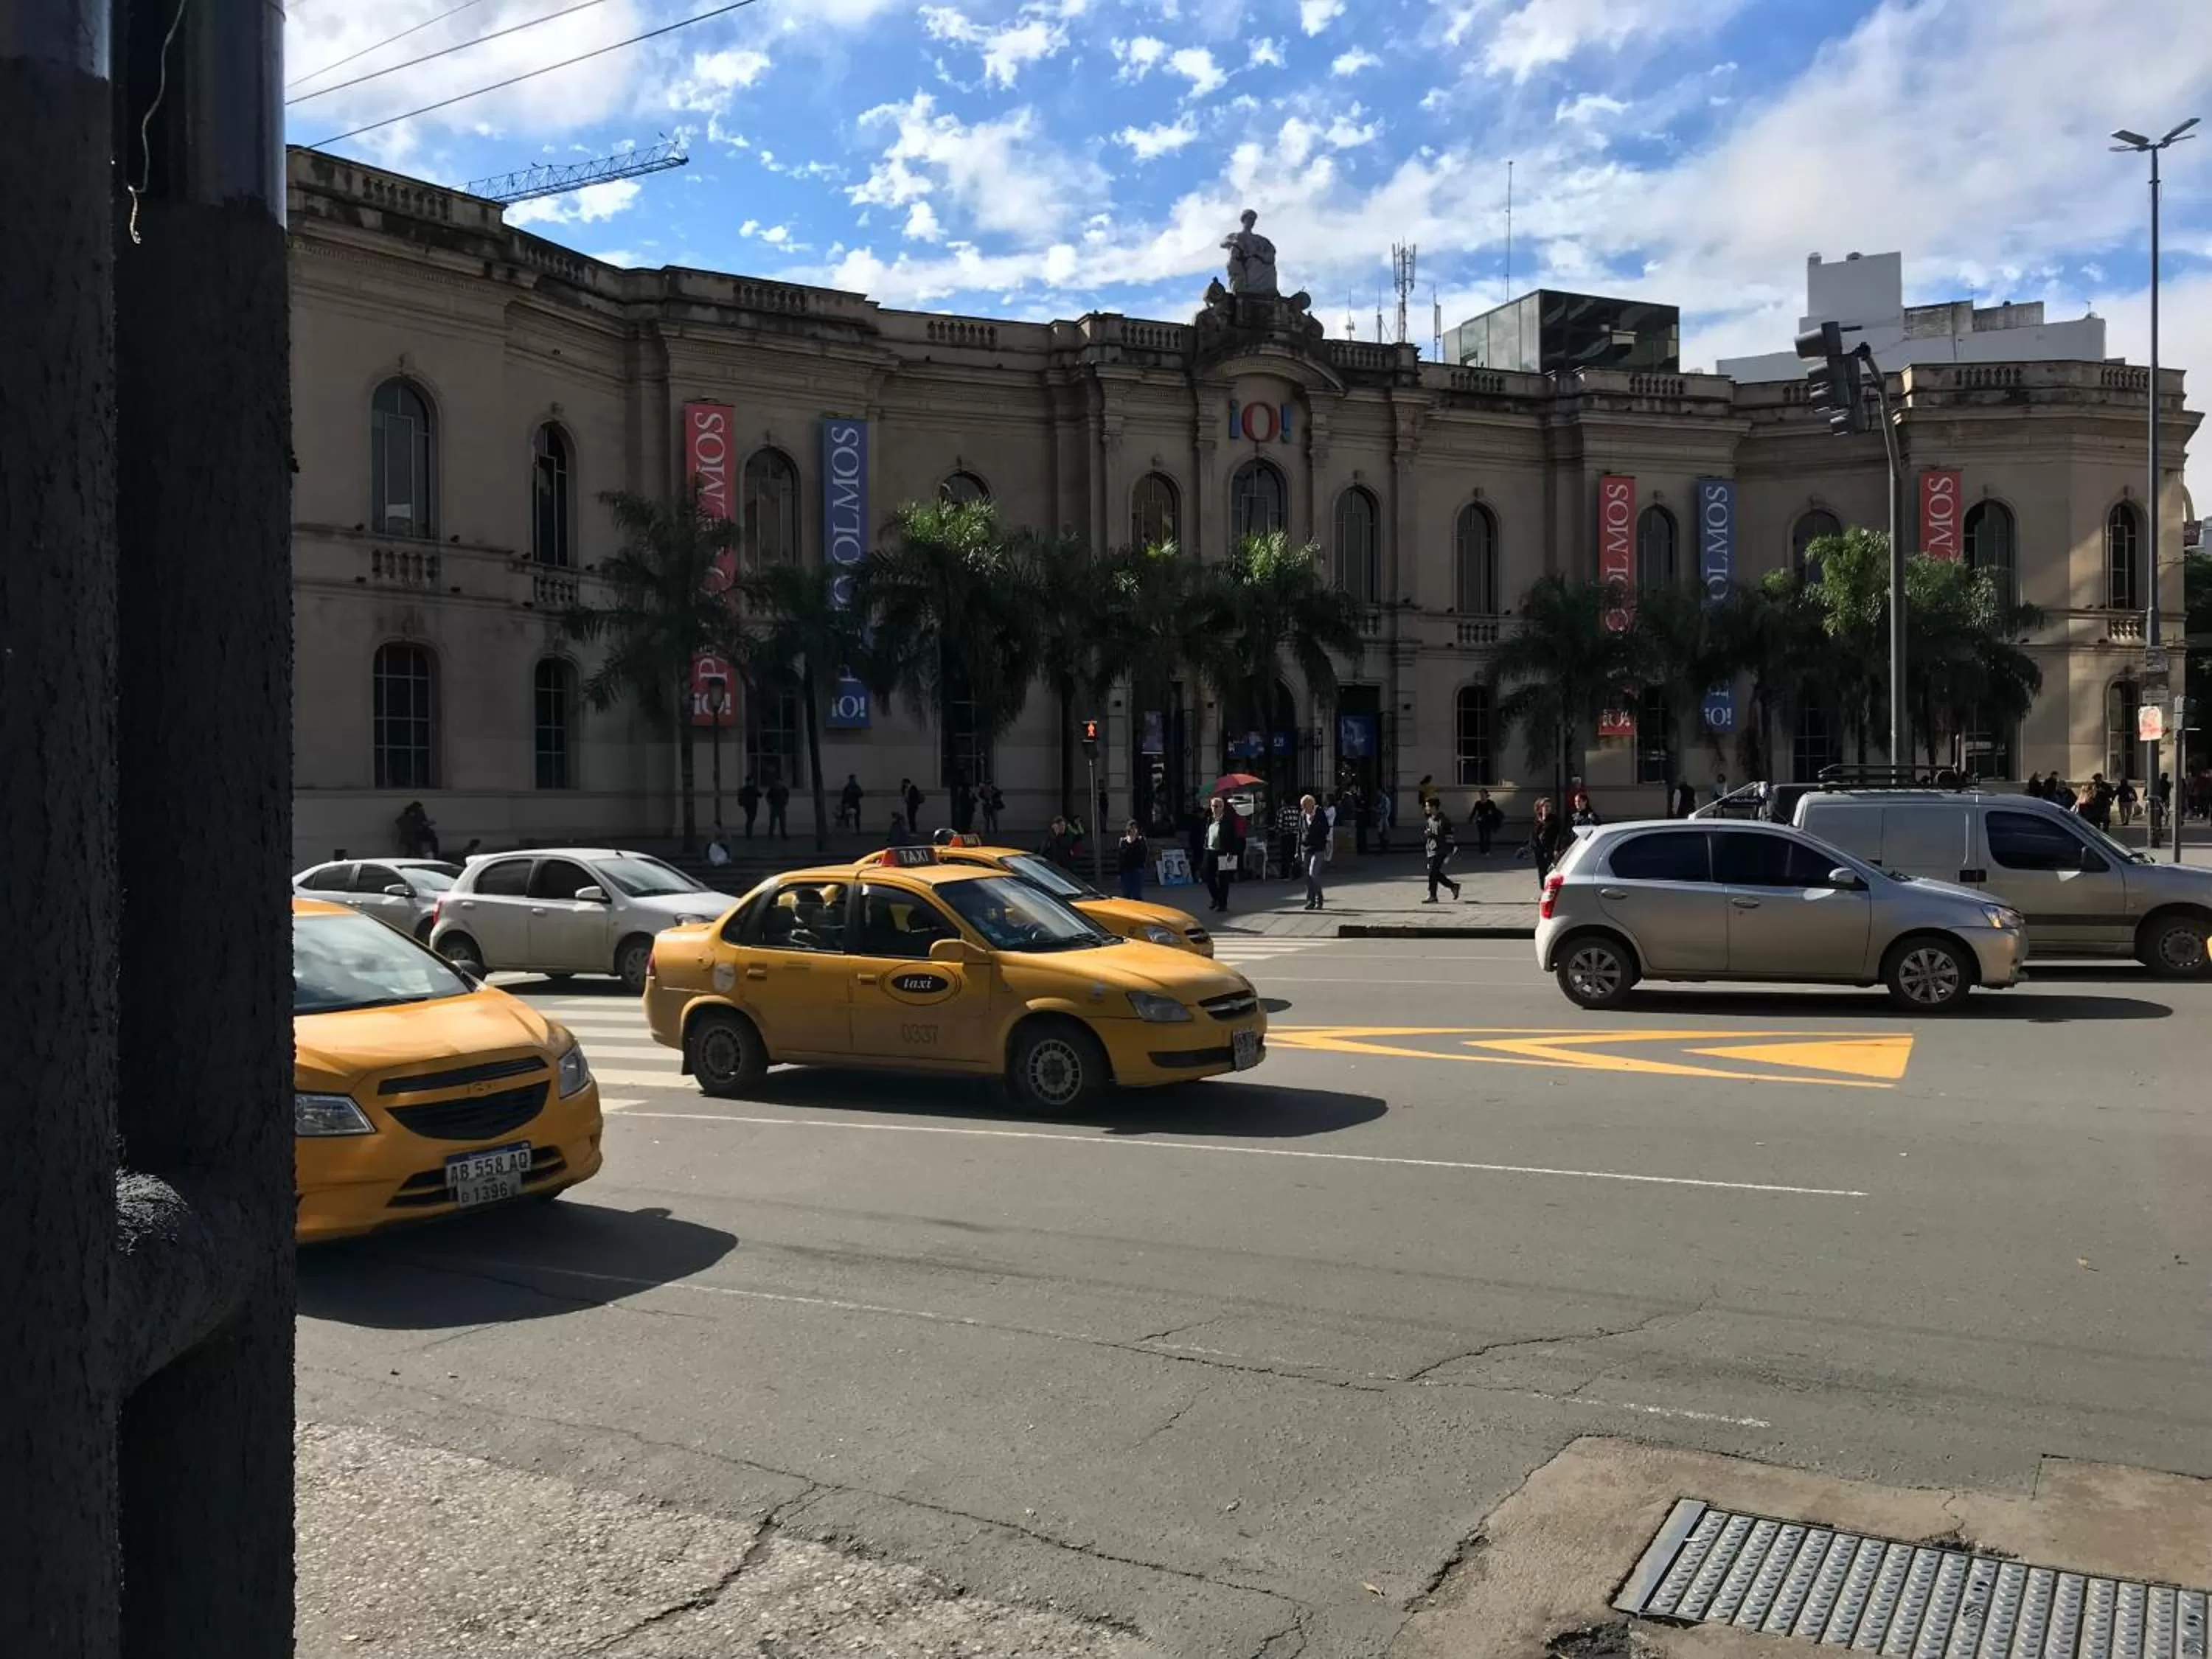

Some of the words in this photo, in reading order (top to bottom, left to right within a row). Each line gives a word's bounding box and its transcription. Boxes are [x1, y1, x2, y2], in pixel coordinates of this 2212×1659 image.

[831, 427, 860, 566] OLMOS
[900, 849, 930, 863] TAXI
[903, 976, 933, 989] taxi
[475, 1155, 504, 1178] 558
[473, 1181, 508, 1203] 1396
